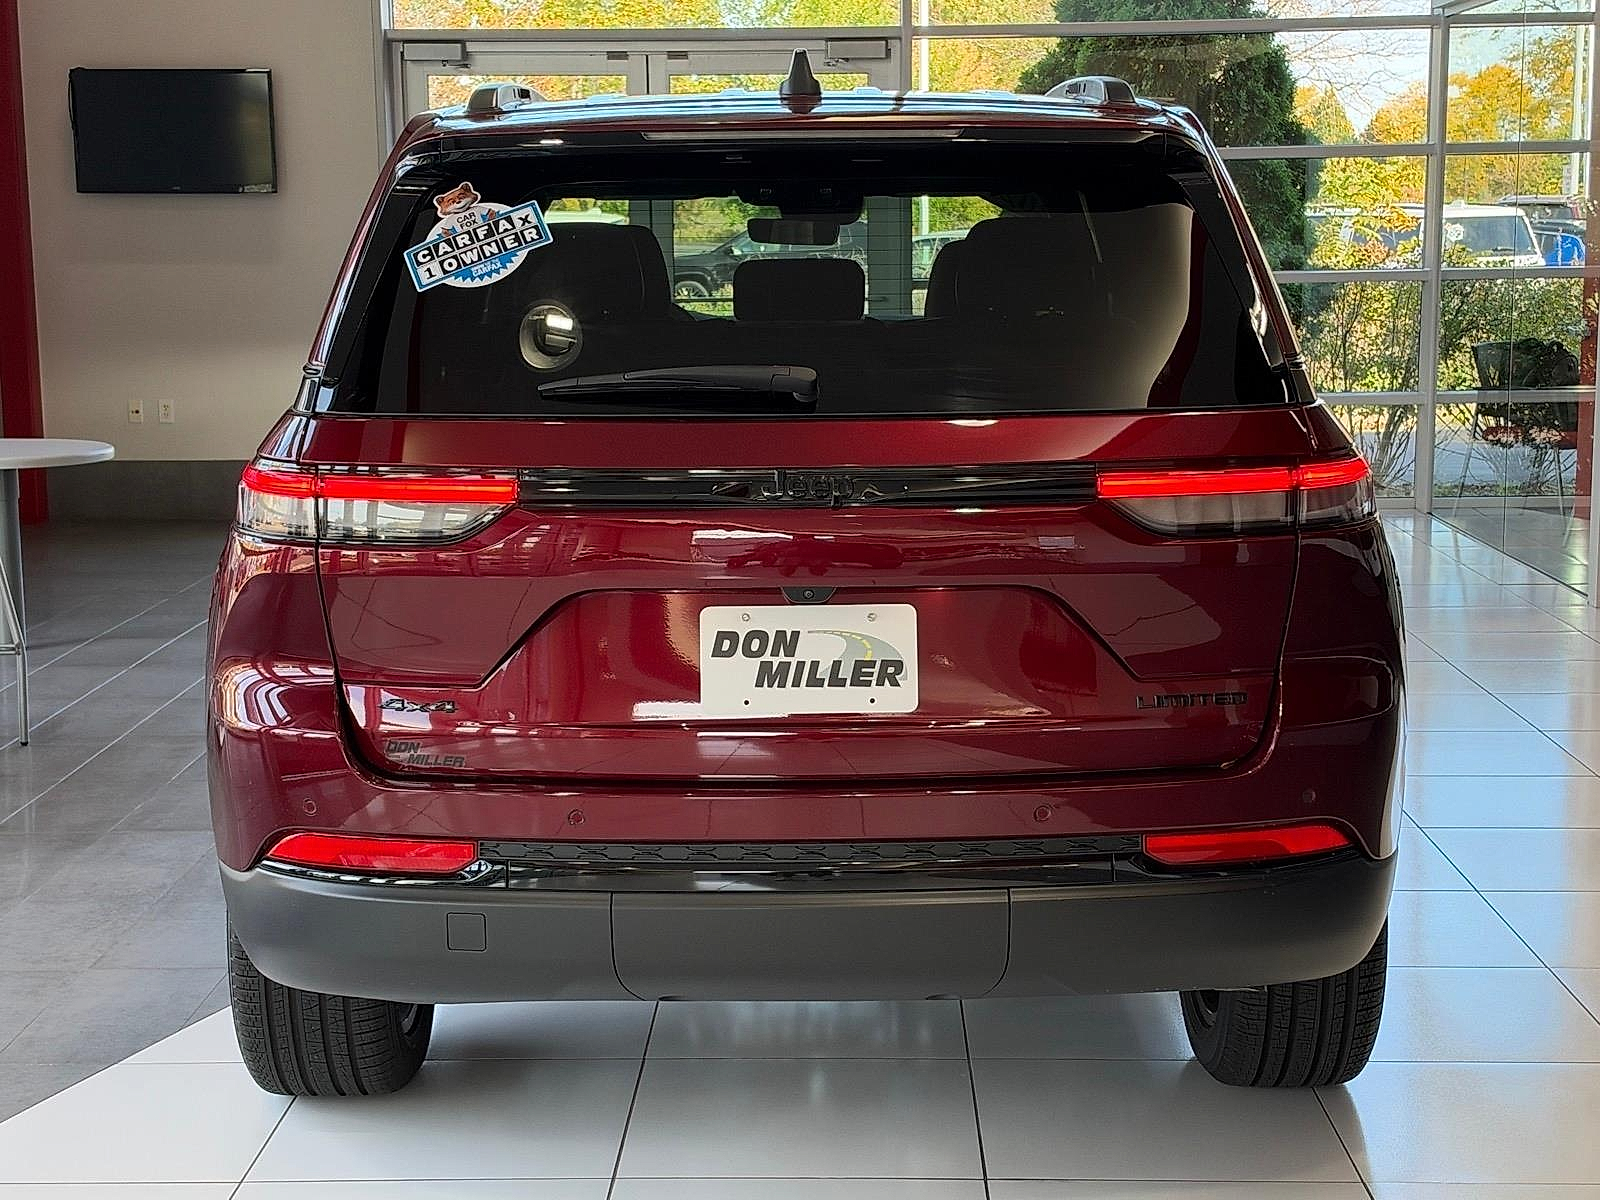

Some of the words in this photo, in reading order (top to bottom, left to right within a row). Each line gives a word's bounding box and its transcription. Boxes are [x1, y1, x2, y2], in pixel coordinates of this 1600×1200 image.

[457, 212, 476, 223] CAR
[460, 219, 478, 230] FOX
[417, 214, 532, 263] CARFAX
[424, 266, 437, 280] 1
[443, 229, 540, 272] OWNER
[472, 262, 502, 277] CARFAX
[761, 470, 853, 509] Jeep
[711, 630, 800, 658] DON
[755, 660, 904, 688] MILLER
[1136, 692, 1248, 708] LIMITED
[386, 741, 421, 753] DON
[407, 754, 465, 767] MILLER
